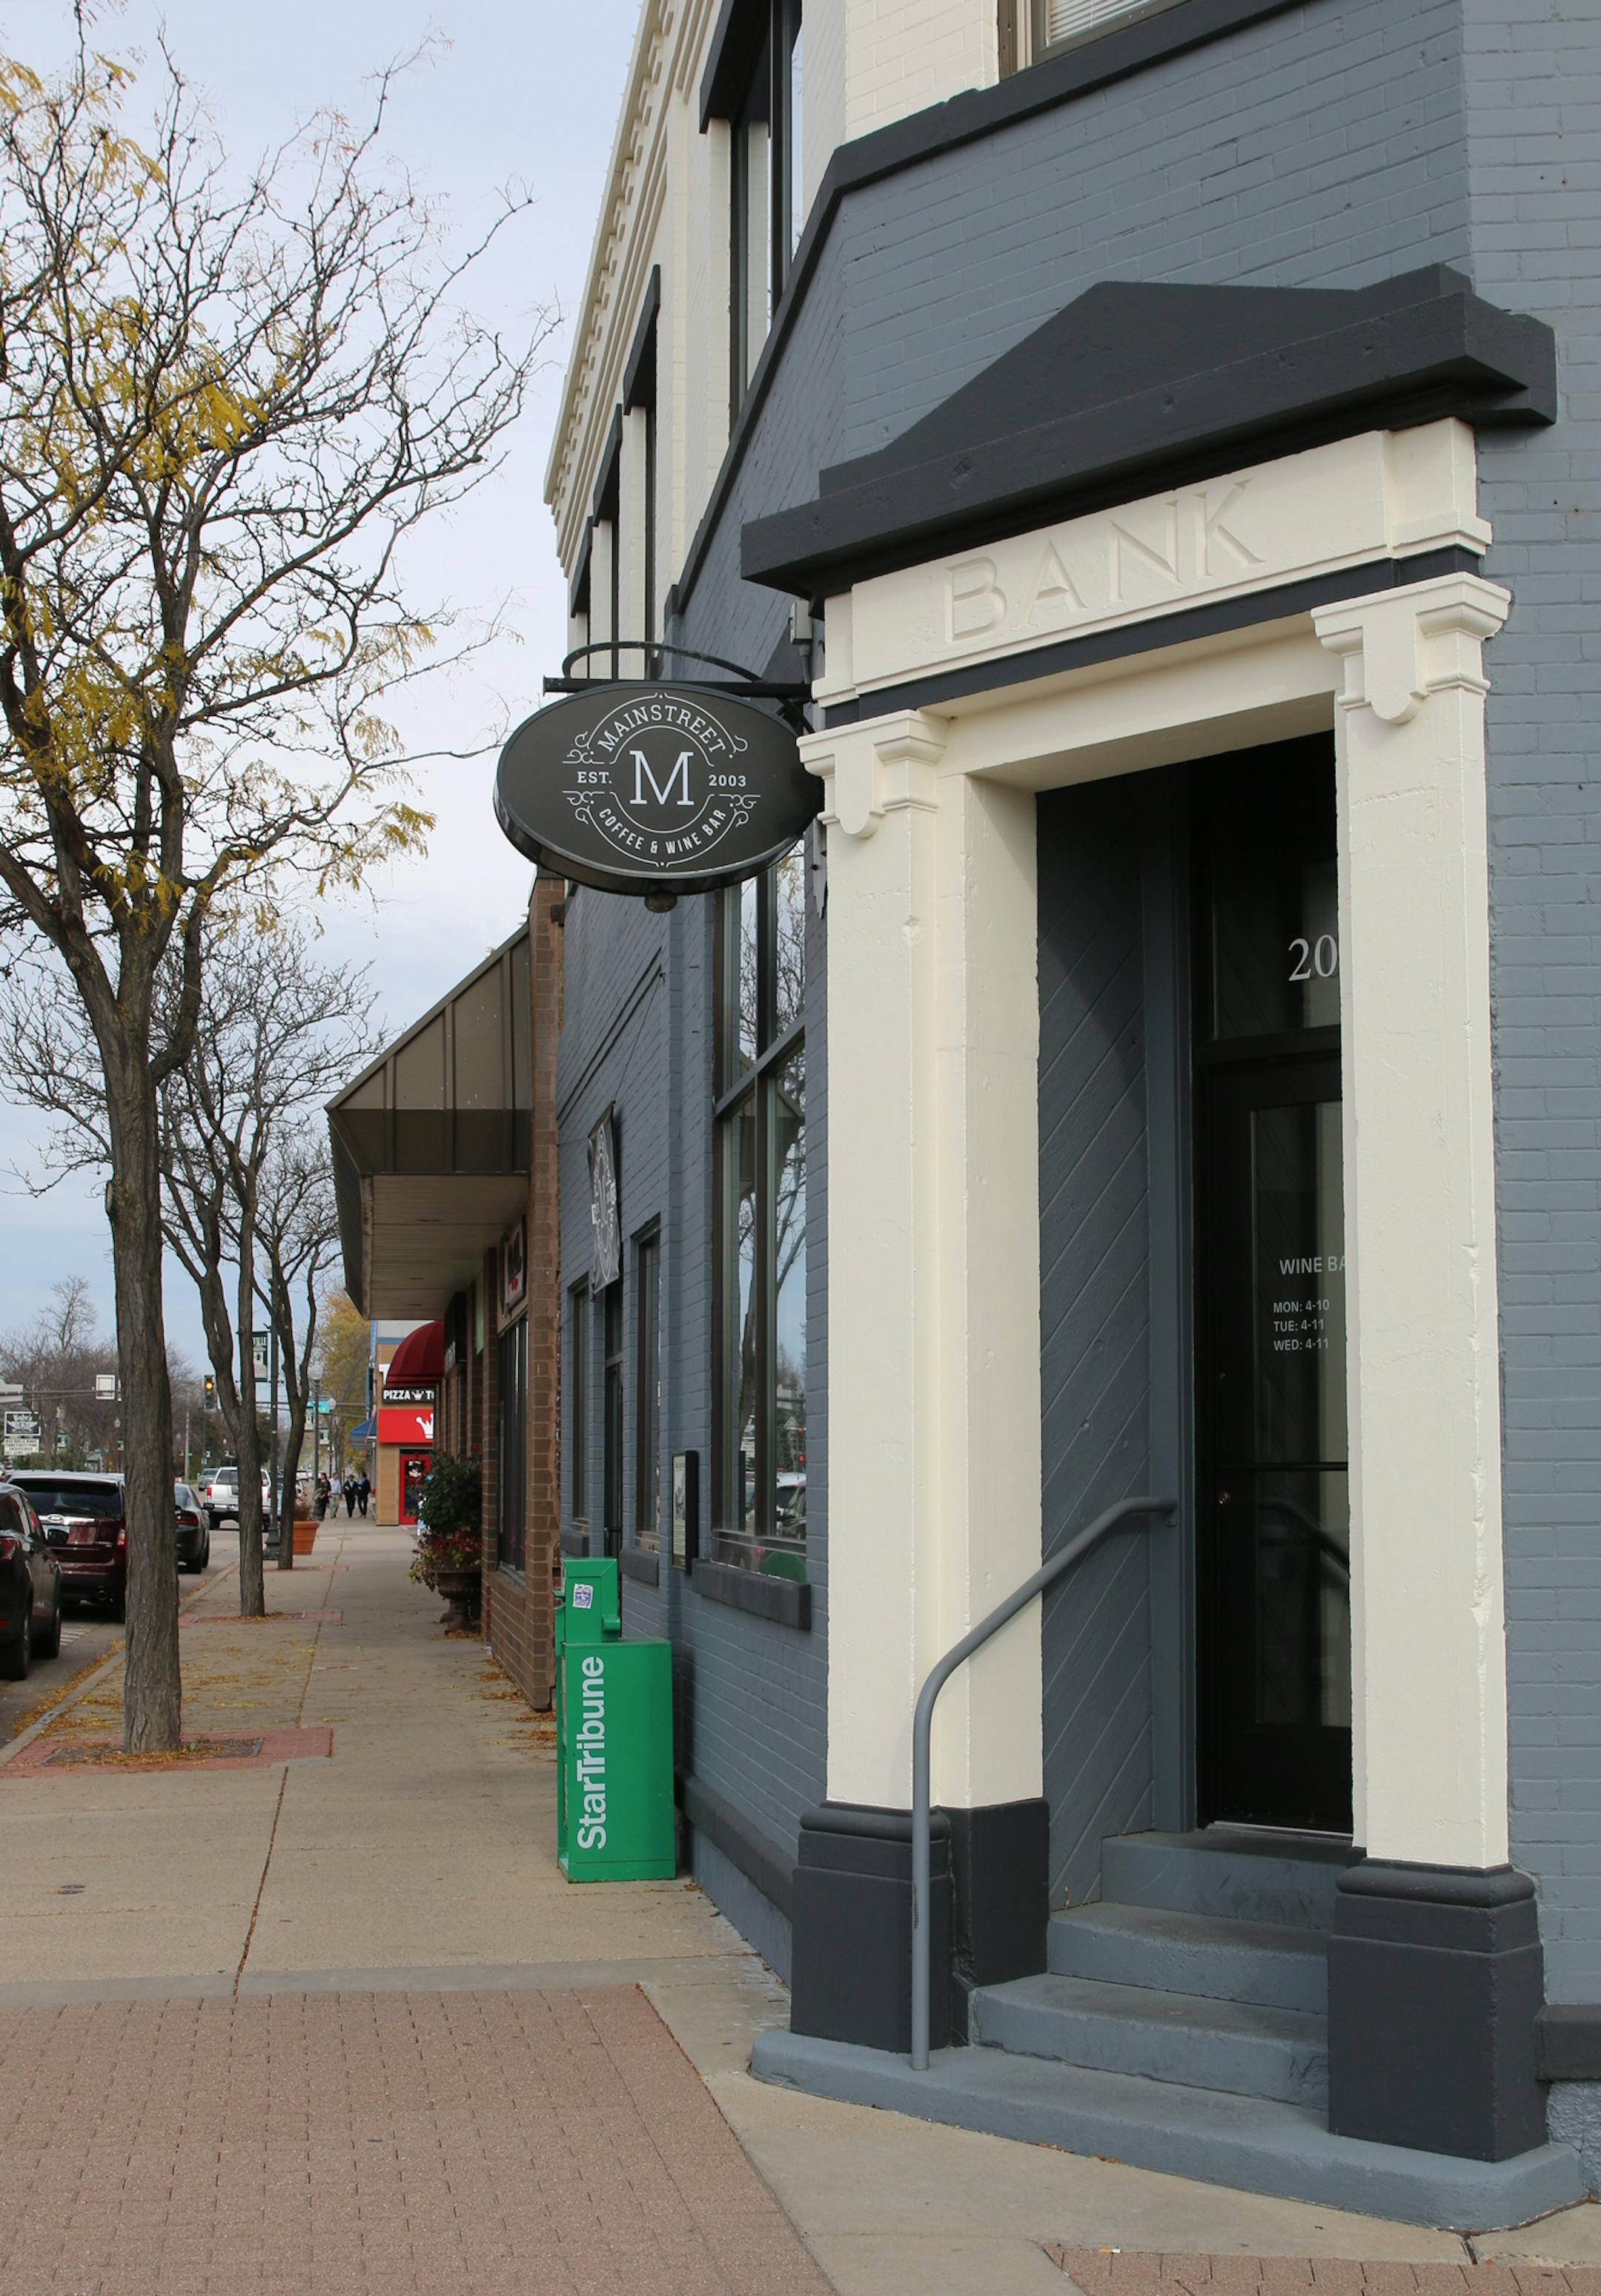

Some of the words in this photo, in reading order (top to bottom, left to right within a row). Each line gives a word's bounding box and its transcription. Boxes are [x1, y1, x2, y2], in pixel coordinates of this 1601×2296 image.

[944, 477, 1268, 644] BANK
[597, 704, 726, 753] MAINSTREET
[577, 771, 612, 784] EST.
[629, 750, 695, 806] M
[709, 774, 747, 787] 2003
[599, 808, 645, 850] COFFEE
[650, 841, 659, 854] &
[666, 833, 702, 854] WINE
[701, 809, 727, 837] BAR
[1279, 1257, 1323, 1275] WINE
[1273, 1301, 1303, 1313] MON:
[1305, 1299, 1330, 1311] 4-10
[1273, 1320, 1299, 1332] TUE:
[1301, 1318, 1325, 1331] 4-11
[1273, 1339, 1303, 1352] WED:
[1305, 1337, 1329, 1349] 4-11
[383, 1389, 411, 1400] PIZZA
[576, 1655, 607, 1850] StarTribune
